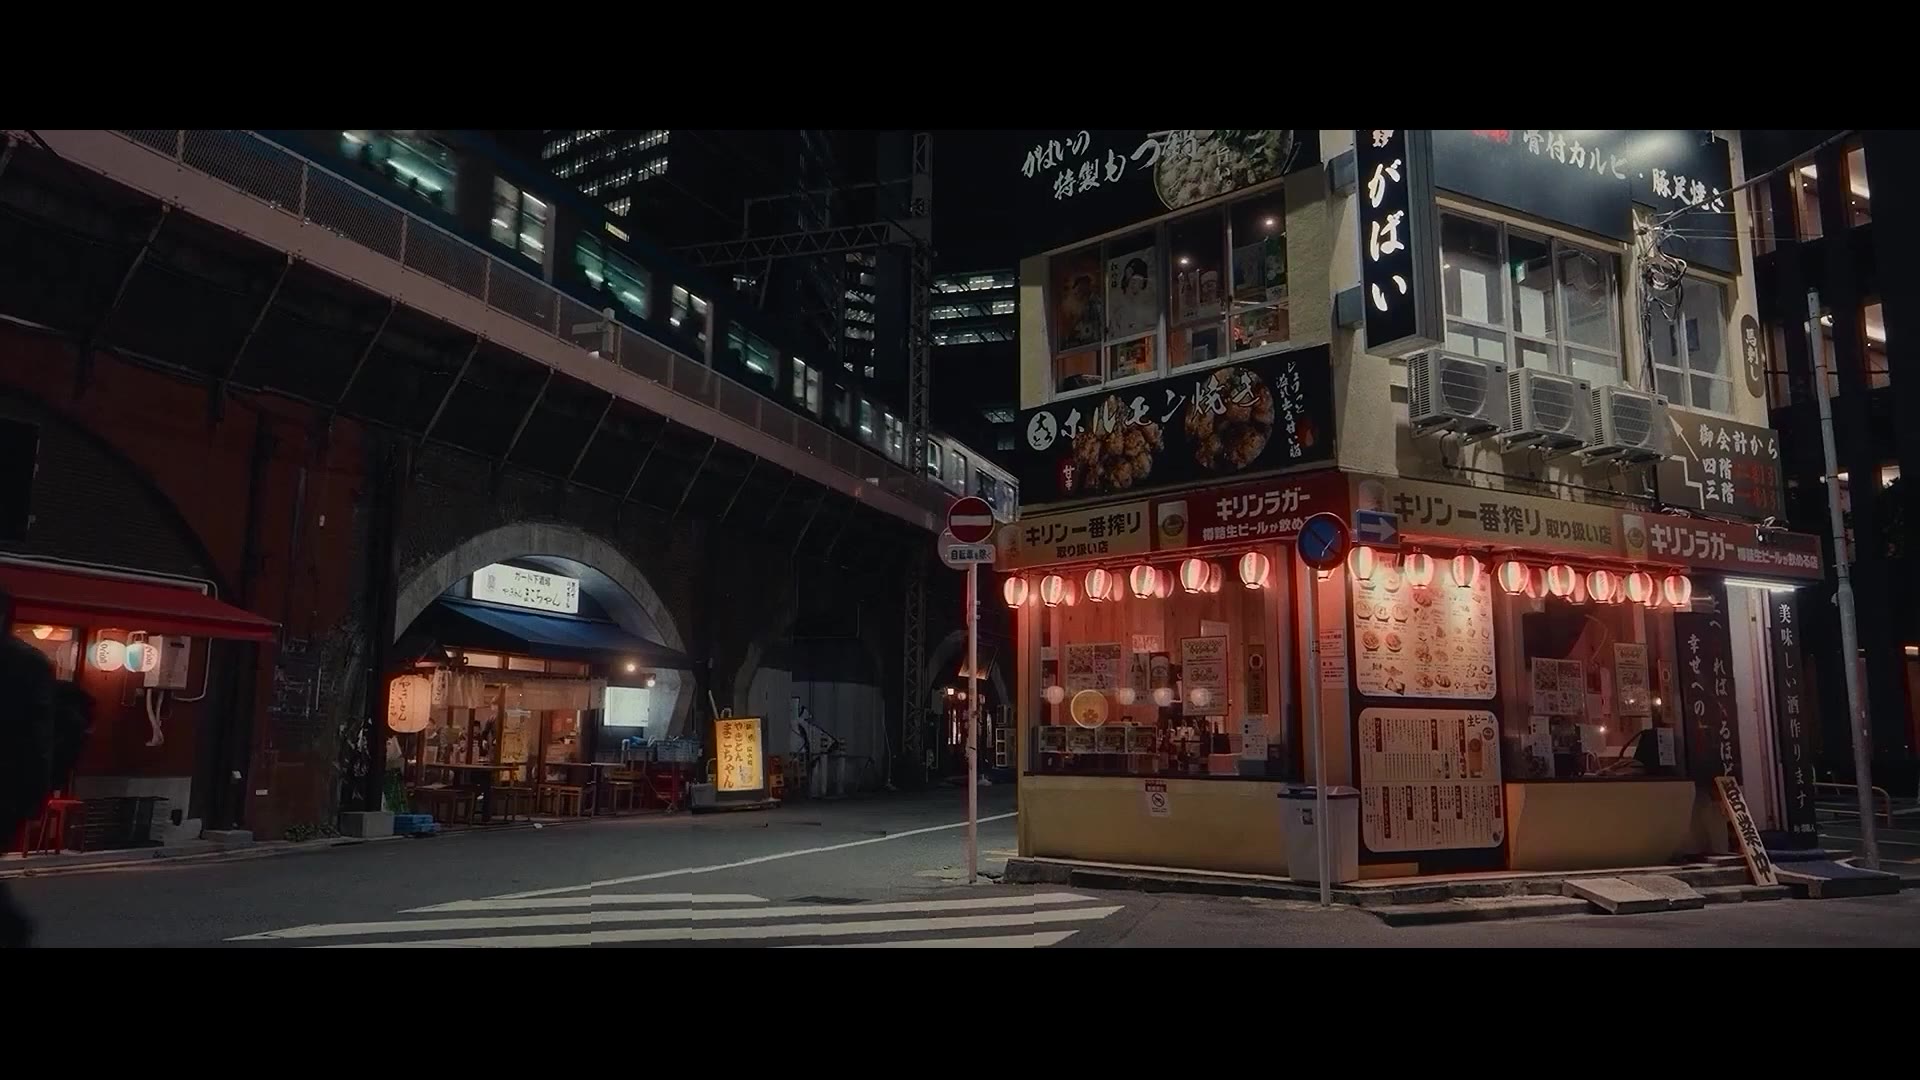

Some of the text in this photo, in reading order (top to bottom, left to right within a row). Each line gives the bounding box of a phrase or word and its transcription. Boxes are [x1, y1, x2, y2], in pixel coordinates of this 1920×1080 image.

[1021, 130, 1091, 179] がばいの
[1060, 371, 1261, 440] ホルモン焼き
[1698, 423, 1779, 460] 御会計から
[1702, 457, 1733, 480] 四階
[1215, 489, 1312, 521] キリンラガー
[1705, 480, 1735, 505] 三階
[1025, 510, 1142, 547] キリン一番搾り
[1202, 515, 1304, 542] 樽詰生ビールが飲め
[1393, 492, 1612, 545] キリン一番搾り 取り扱い店
[950, 549, 992, 560] 自転車を除く
[1055, 542, 1109, 559] 取り扱い店
[1650, 522, 1735, 561] キリンラガー
[1778, 603, 1807, 809] 美味しい酒作ります
[722, 721, 735, 789] まこちゃん
[1720, 780, 1771, 883] 営業中
